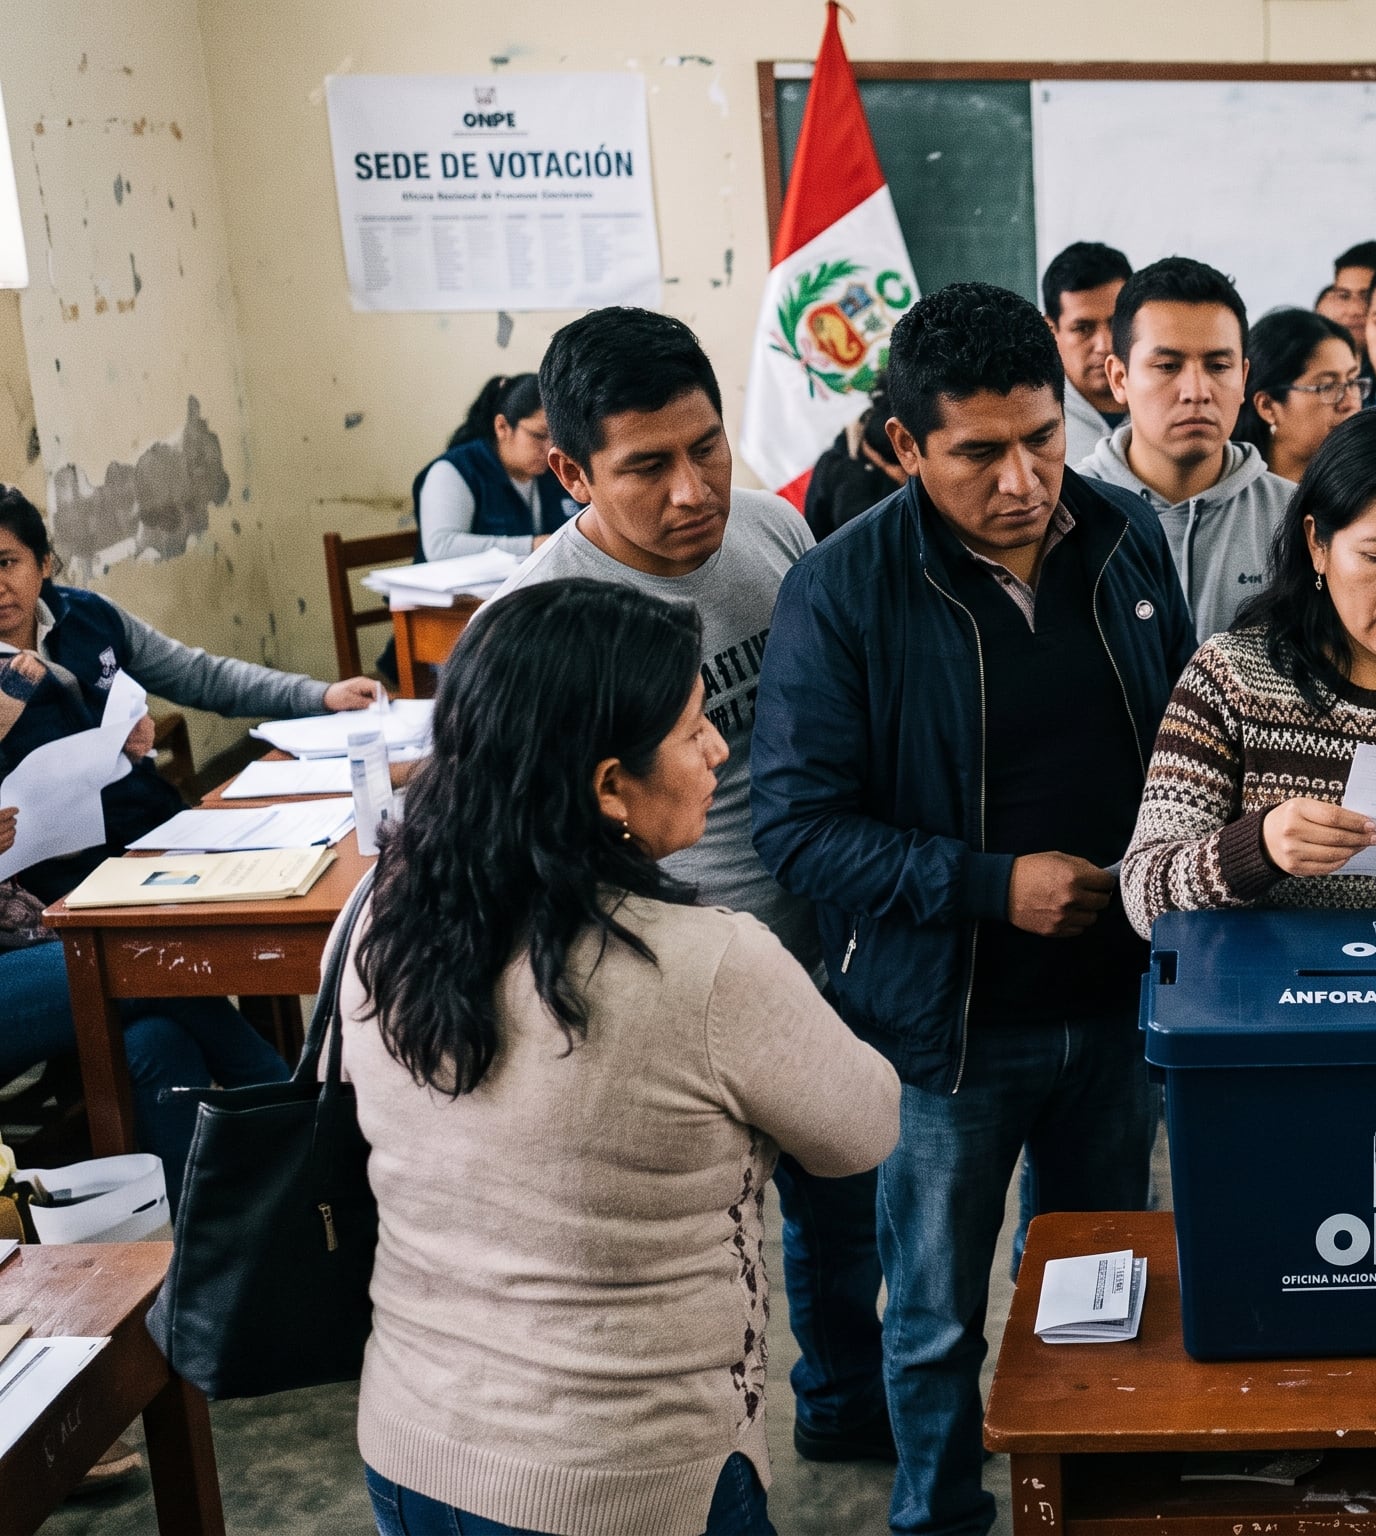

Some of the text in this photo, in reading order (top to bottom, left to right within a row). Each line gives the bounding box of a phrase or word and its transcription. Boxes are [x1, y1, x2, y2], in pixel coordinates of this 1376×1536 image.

[463, 112, 516, 128] ONPE
[354, 144, 634, 180] SEDE DE VOTACIÓN
[1282, 1274, 1329, 1285] OFICINA
